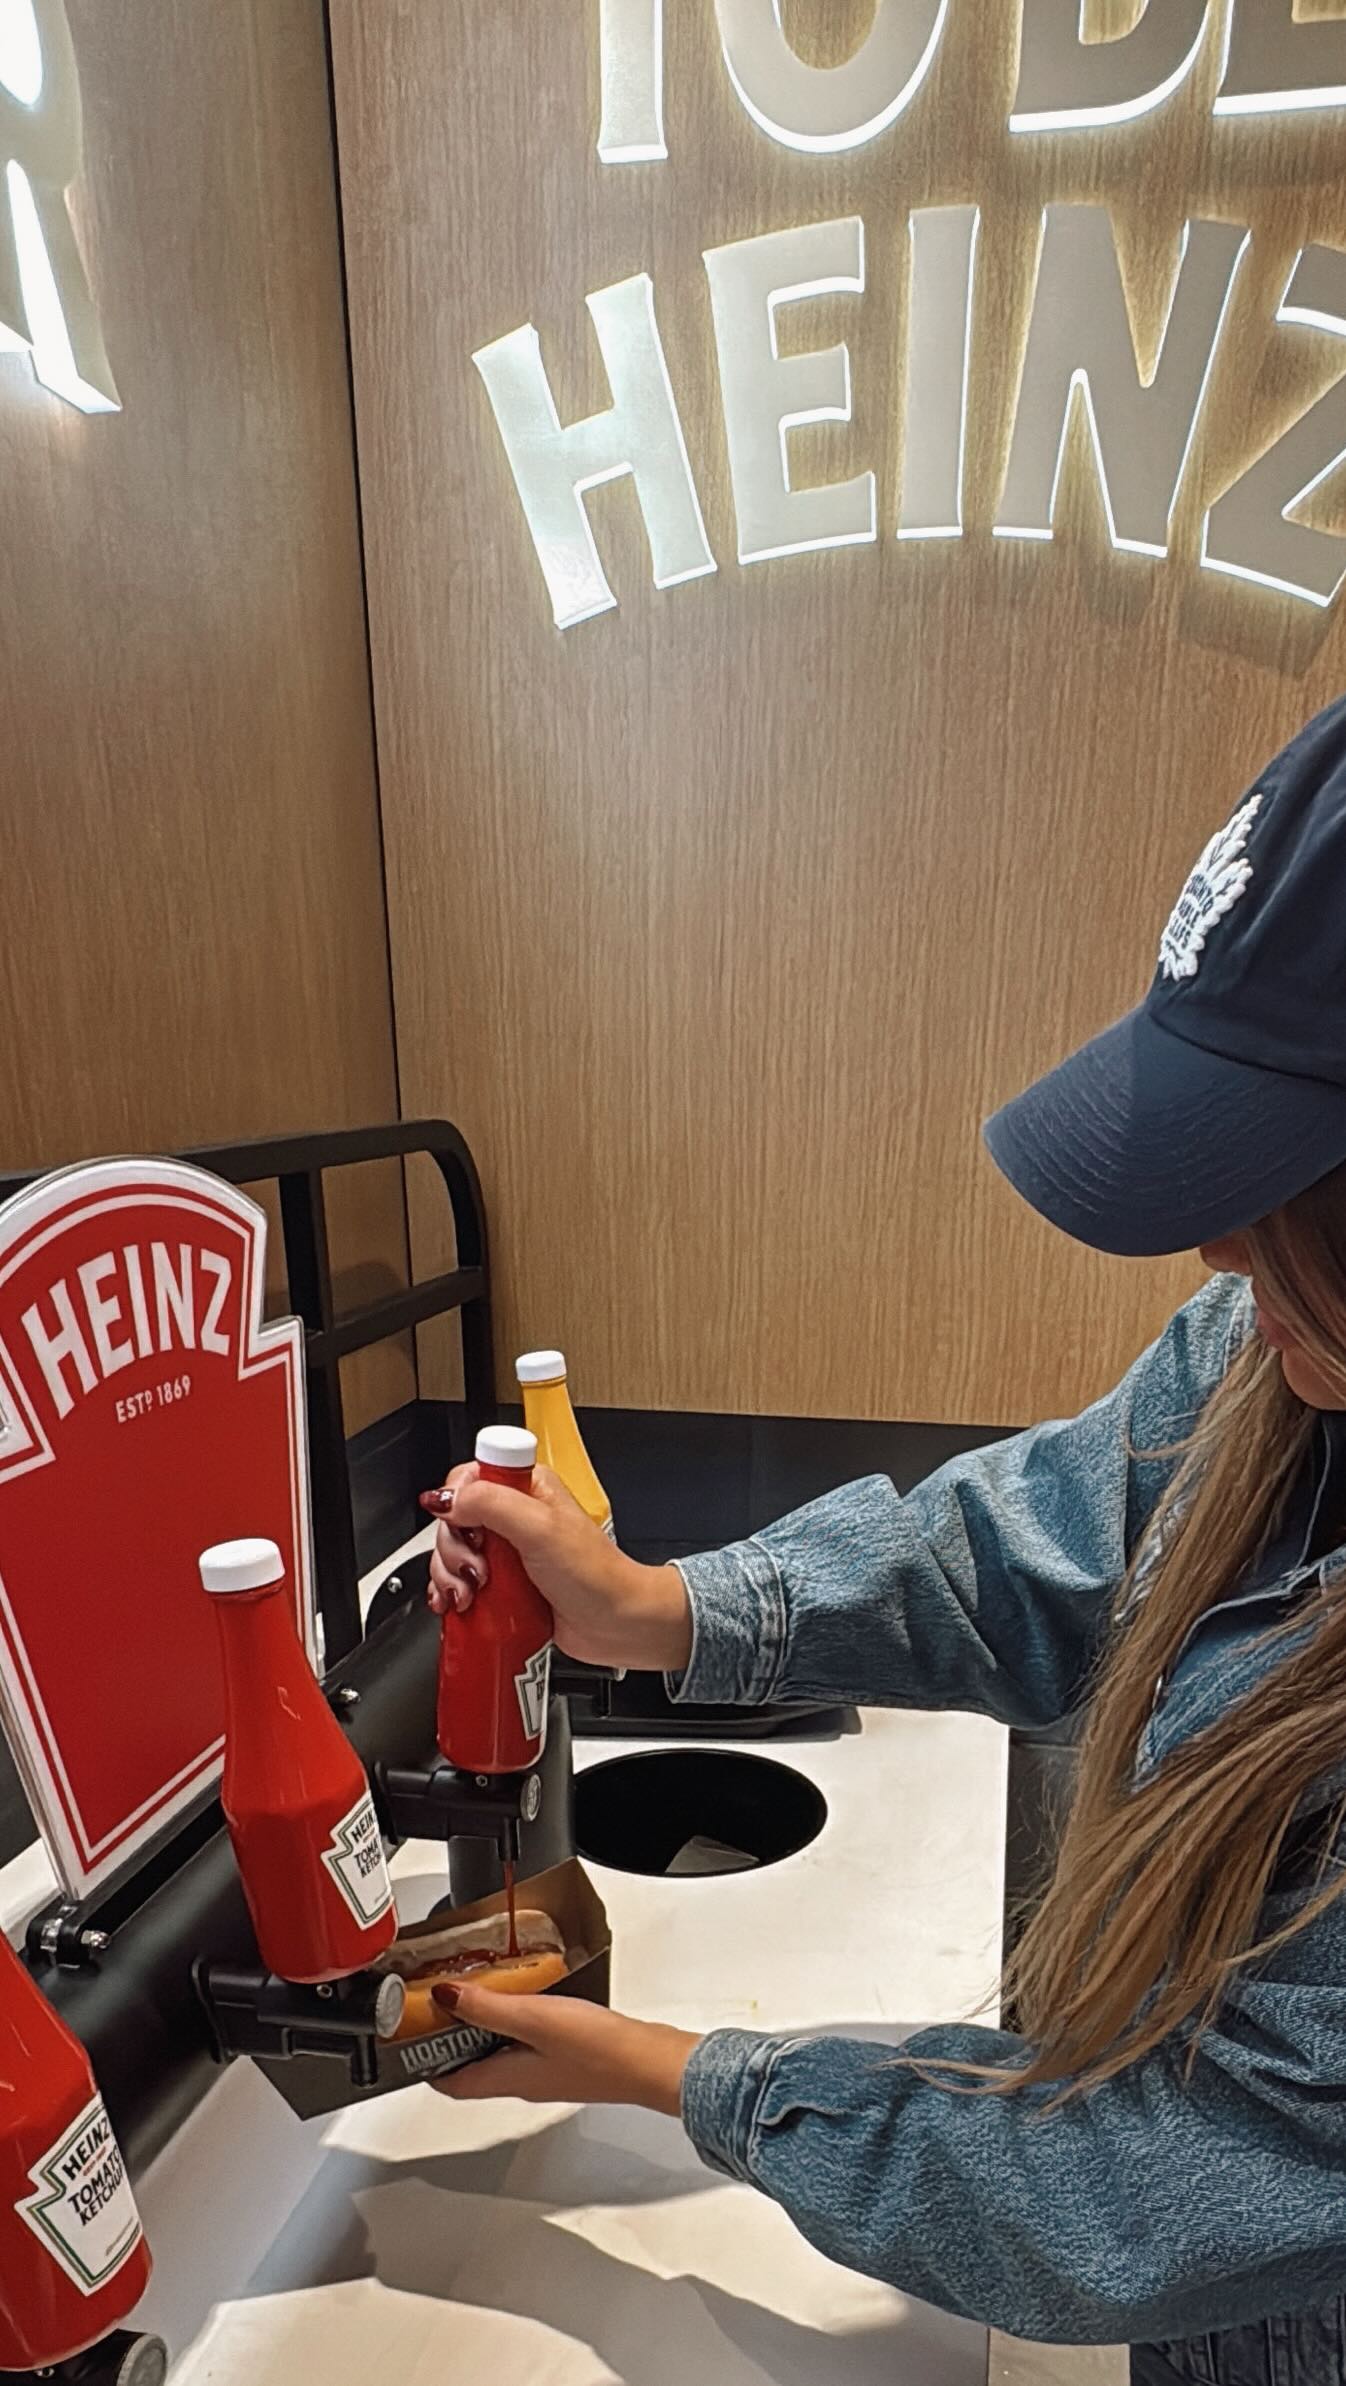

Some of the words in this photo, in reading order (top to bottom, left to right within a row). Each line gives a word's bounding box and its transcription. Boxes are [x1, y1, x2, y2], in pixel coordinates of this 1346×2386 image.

[471, 200, 1346, 631] HEINZ
[21, 1241, 232, 1421] HEINZ
[157, 1375, 191, 1407] 1869
[351, 1808, 375, 1843] HEIN
[401, 2026, 494, 2070] HOGTOW
[61, 2116, 111, 2181] HEINZ
